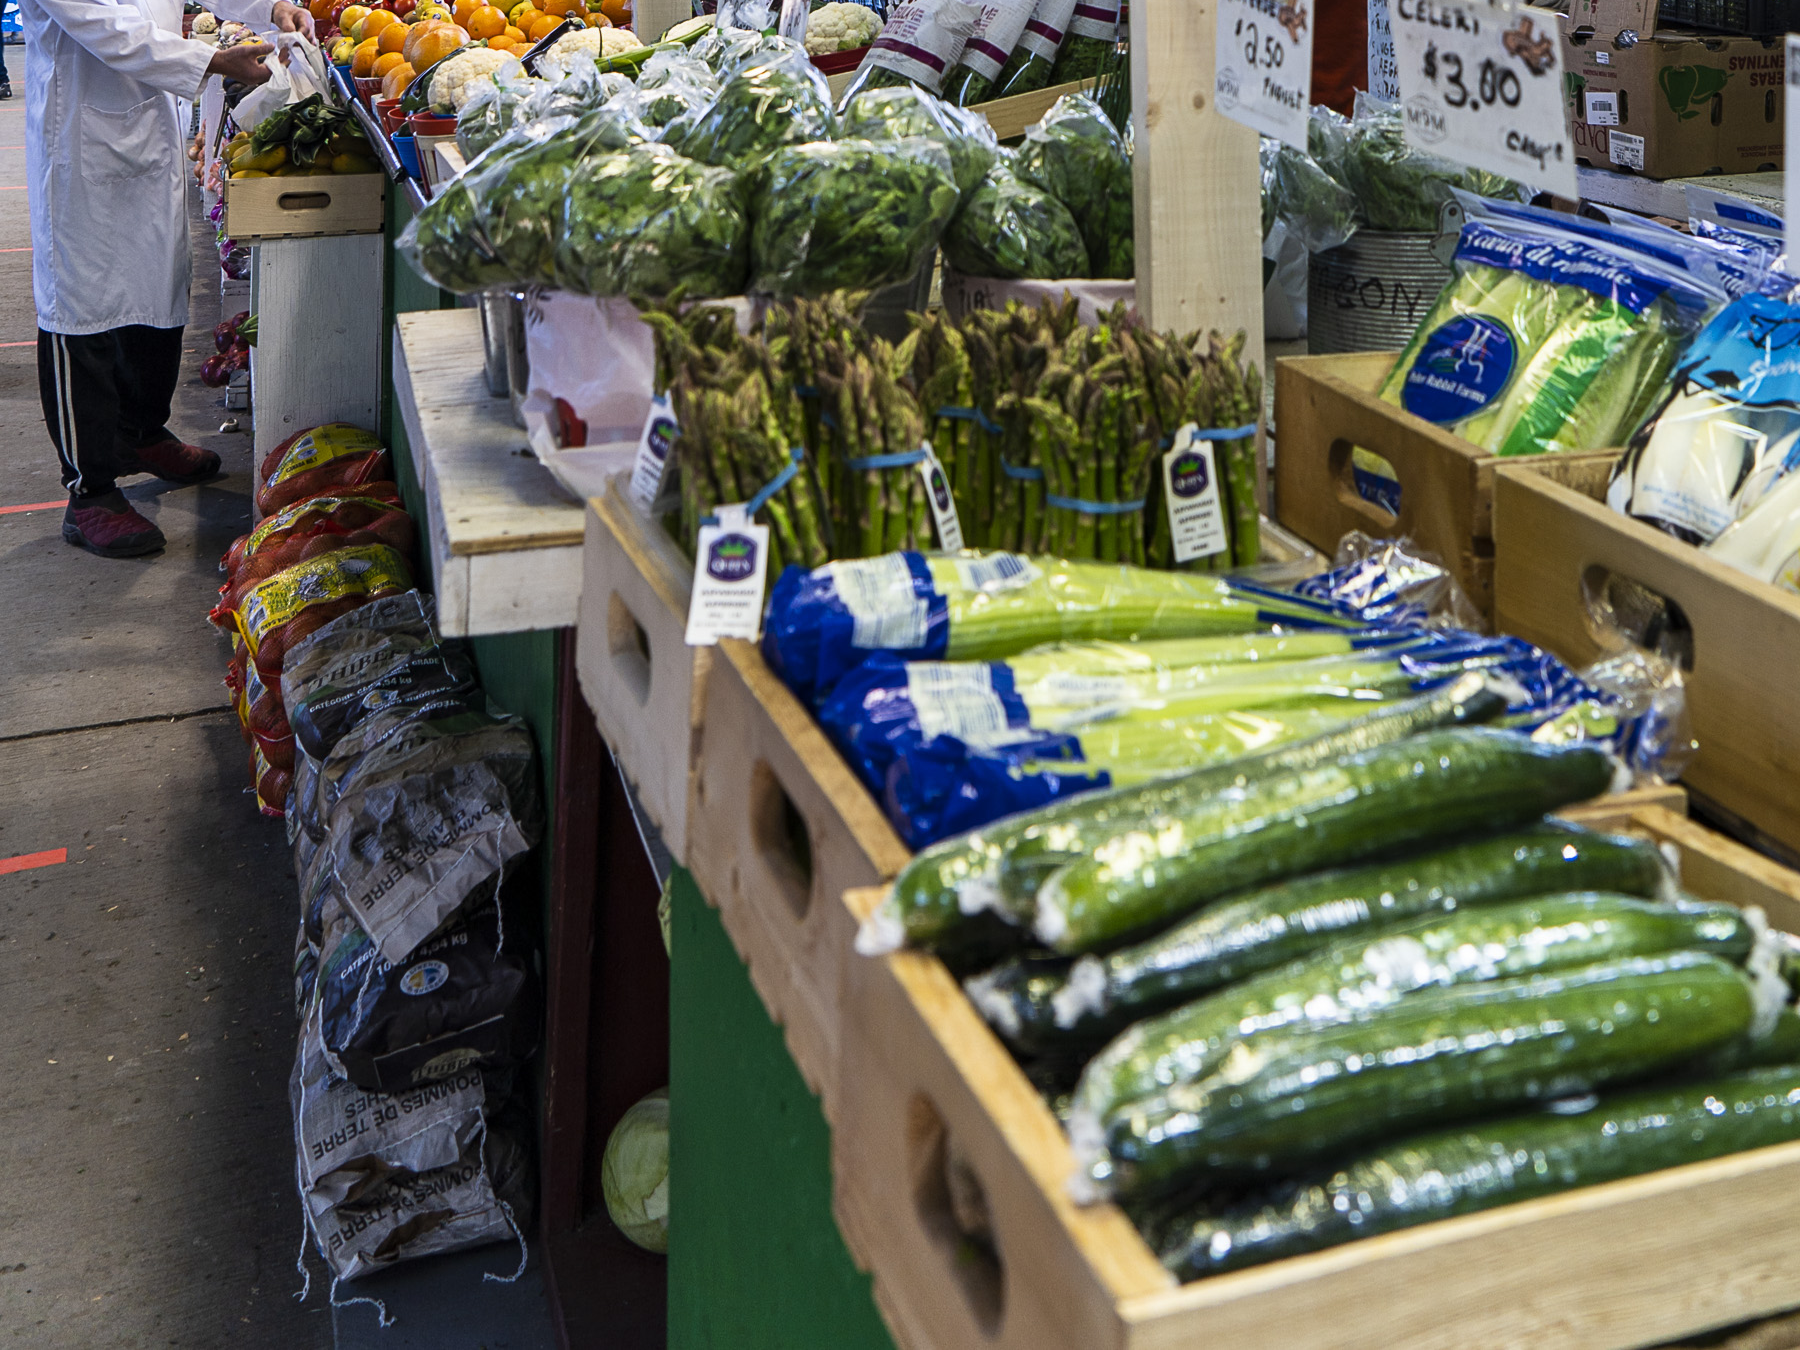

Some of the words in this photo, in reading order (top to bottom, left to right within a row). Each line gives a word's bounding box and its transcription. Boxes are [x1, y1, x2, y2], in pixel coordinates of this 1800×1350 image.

[1422, 40, 1522, 112] $3.00
[1728, 54, 1785, 71] ENTINAS
[1750, 71, 1785, 87] ERAS
[1425, 373, 1457, 394] Rabbit
[1454, 383, 1488, 404] Farms
[359, 861, 414, 911] TERRE
[376, 962, 392, 976] 10
[451, 931, 469, 947] kg
[401, 1072, 482, 1113] POMMES
[373, 1105, 399, 1126] DE
[311, 1118, 367, 1160] TERRE
[328, 1208, 388, 1251] TERRE
